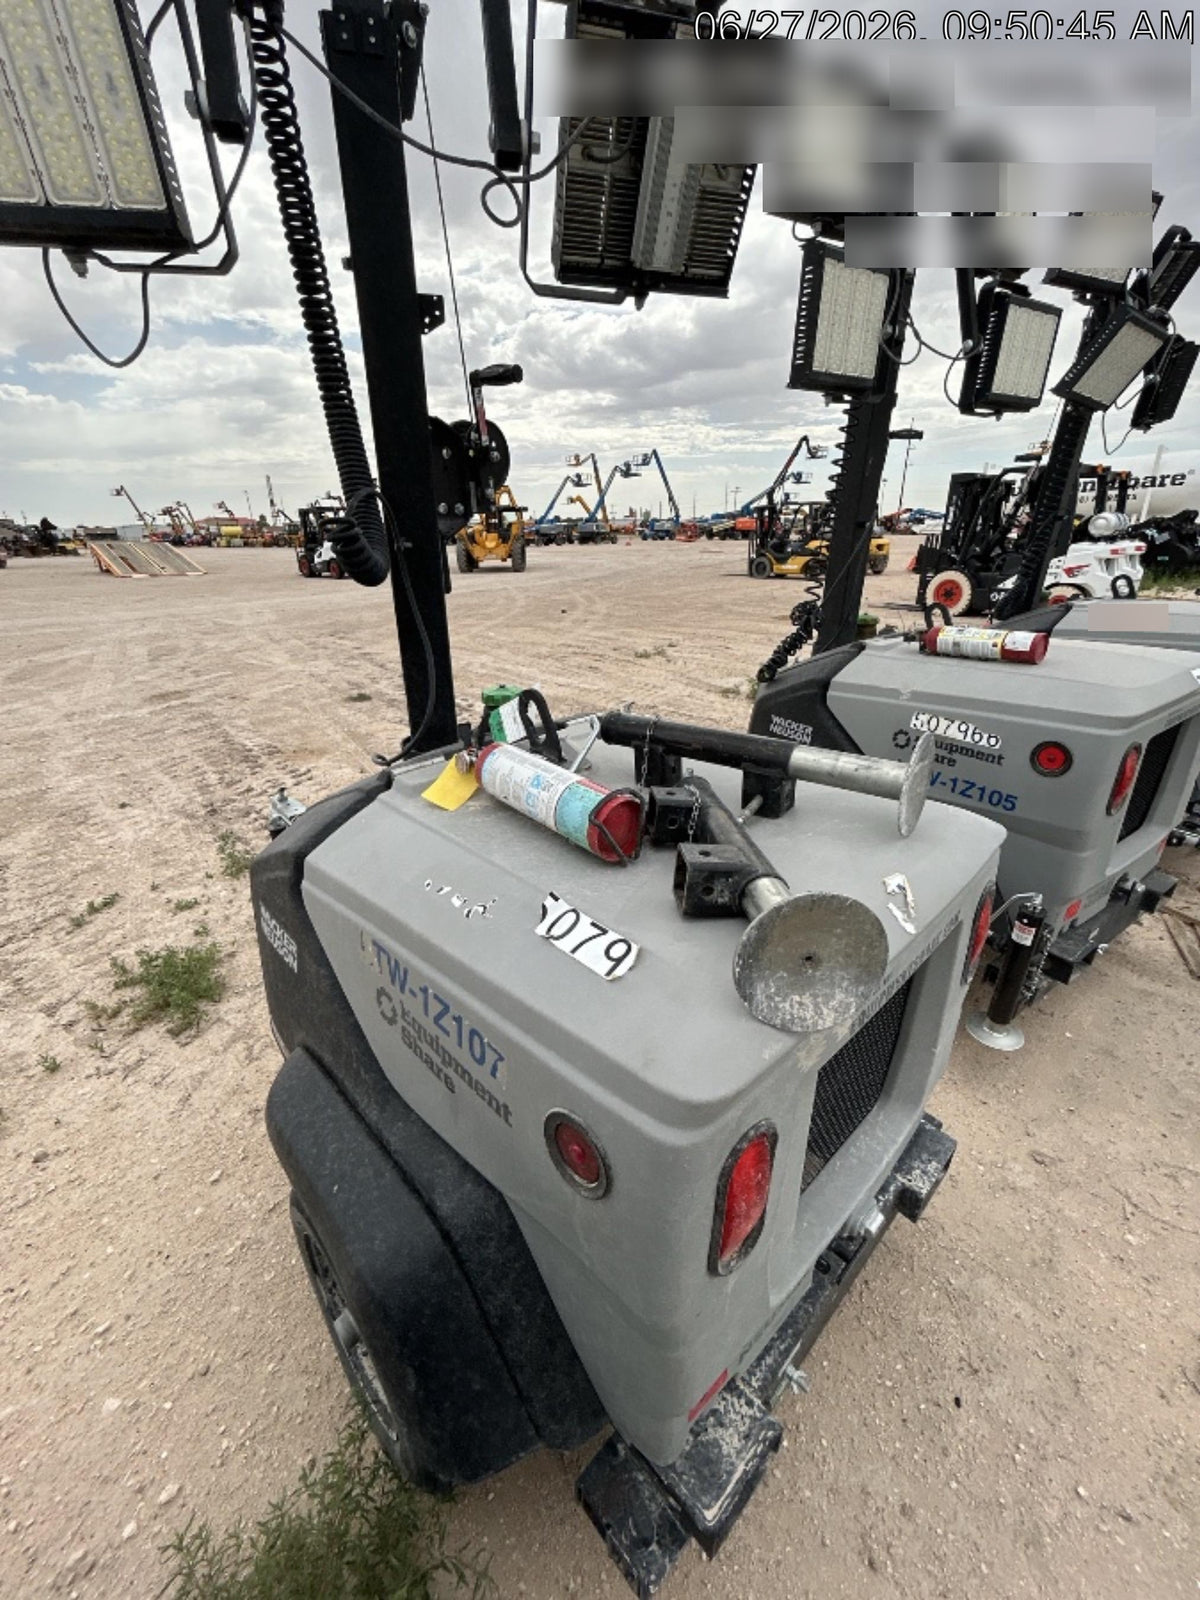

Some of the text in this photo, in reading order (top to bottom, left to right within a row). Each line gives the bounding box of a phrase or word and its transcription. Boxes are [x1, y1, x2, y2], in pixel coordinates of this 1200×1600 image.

[372, 938, 505, 1079] TW-1Z107
[400, 1000, 513, 1127] Equipment
[401, 1025, 456, 1094] Share
